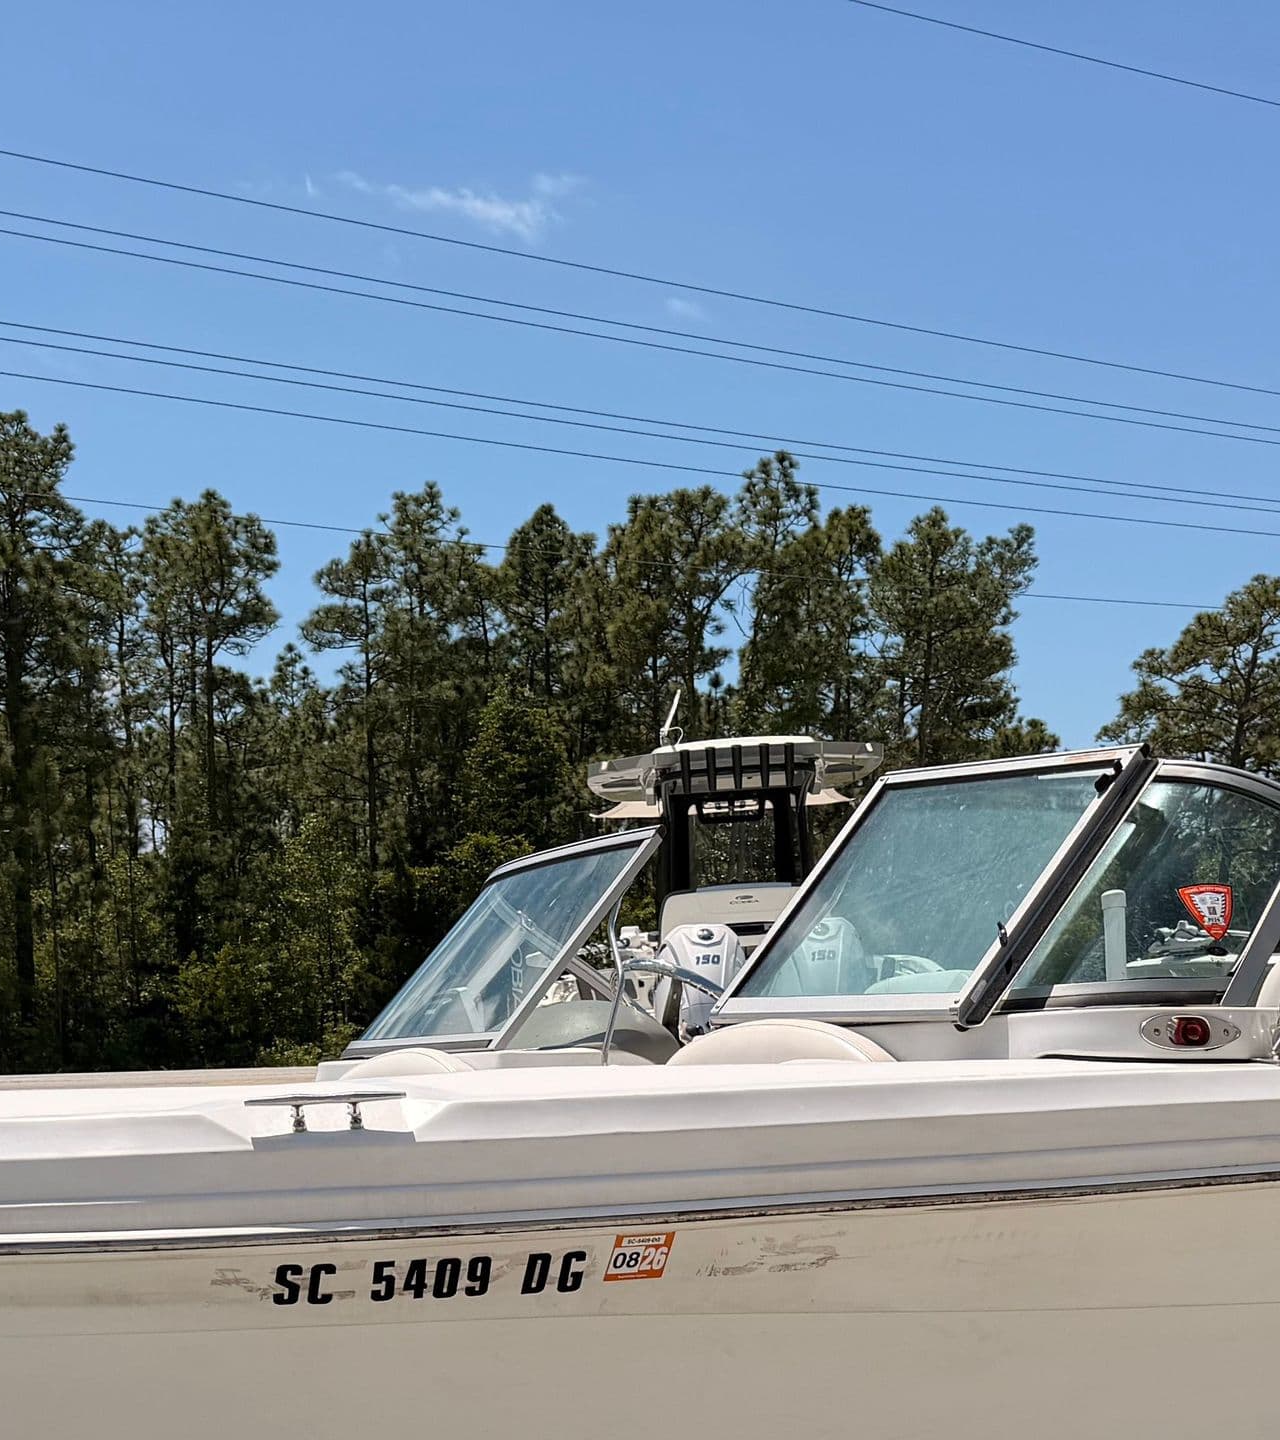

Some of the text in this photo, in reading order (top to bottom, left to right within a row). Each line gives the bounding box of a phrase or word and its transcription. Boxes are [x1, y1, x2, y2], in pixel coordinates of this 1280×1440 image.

[695, 954, 721, 966] 150
[612, 1246, 669, 1271] 08 26
[272, 1250, 587, 1306] SC 5409 DG
